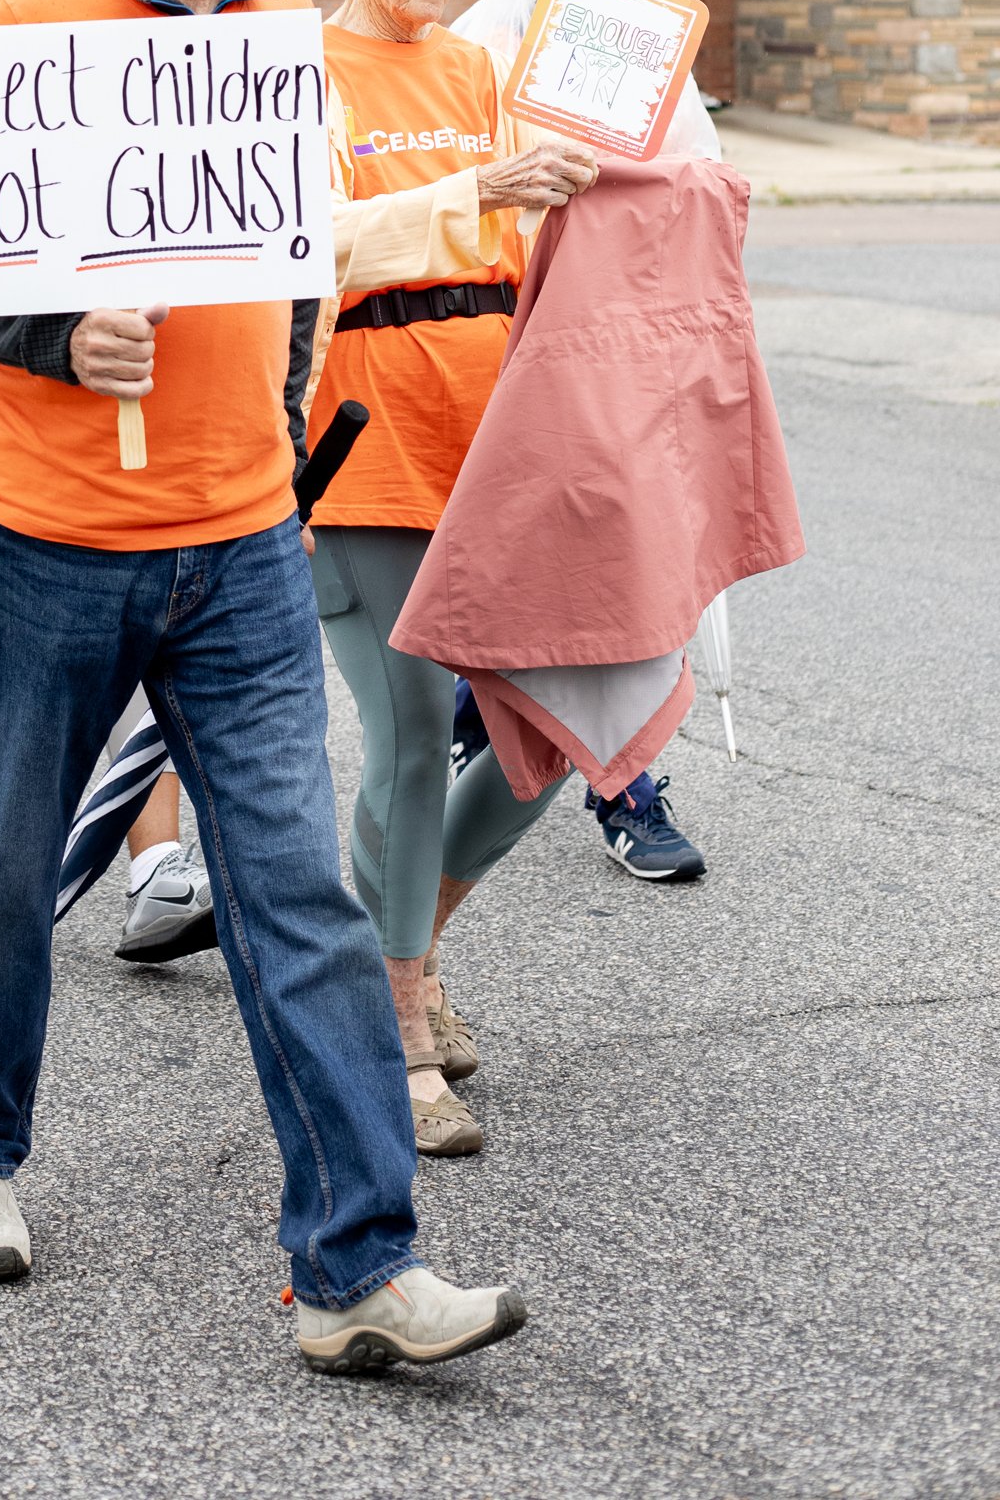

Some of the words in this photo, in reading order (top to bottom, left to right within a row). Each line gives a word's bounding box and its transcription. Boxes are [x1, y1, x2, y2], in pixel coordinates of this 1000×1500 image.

[553, 29, 578, 44] END
[561, 3, 671, 67] ENOUGH
[122, 37, 324, 127] children
[106, 133, 310, 260] GUNS!
